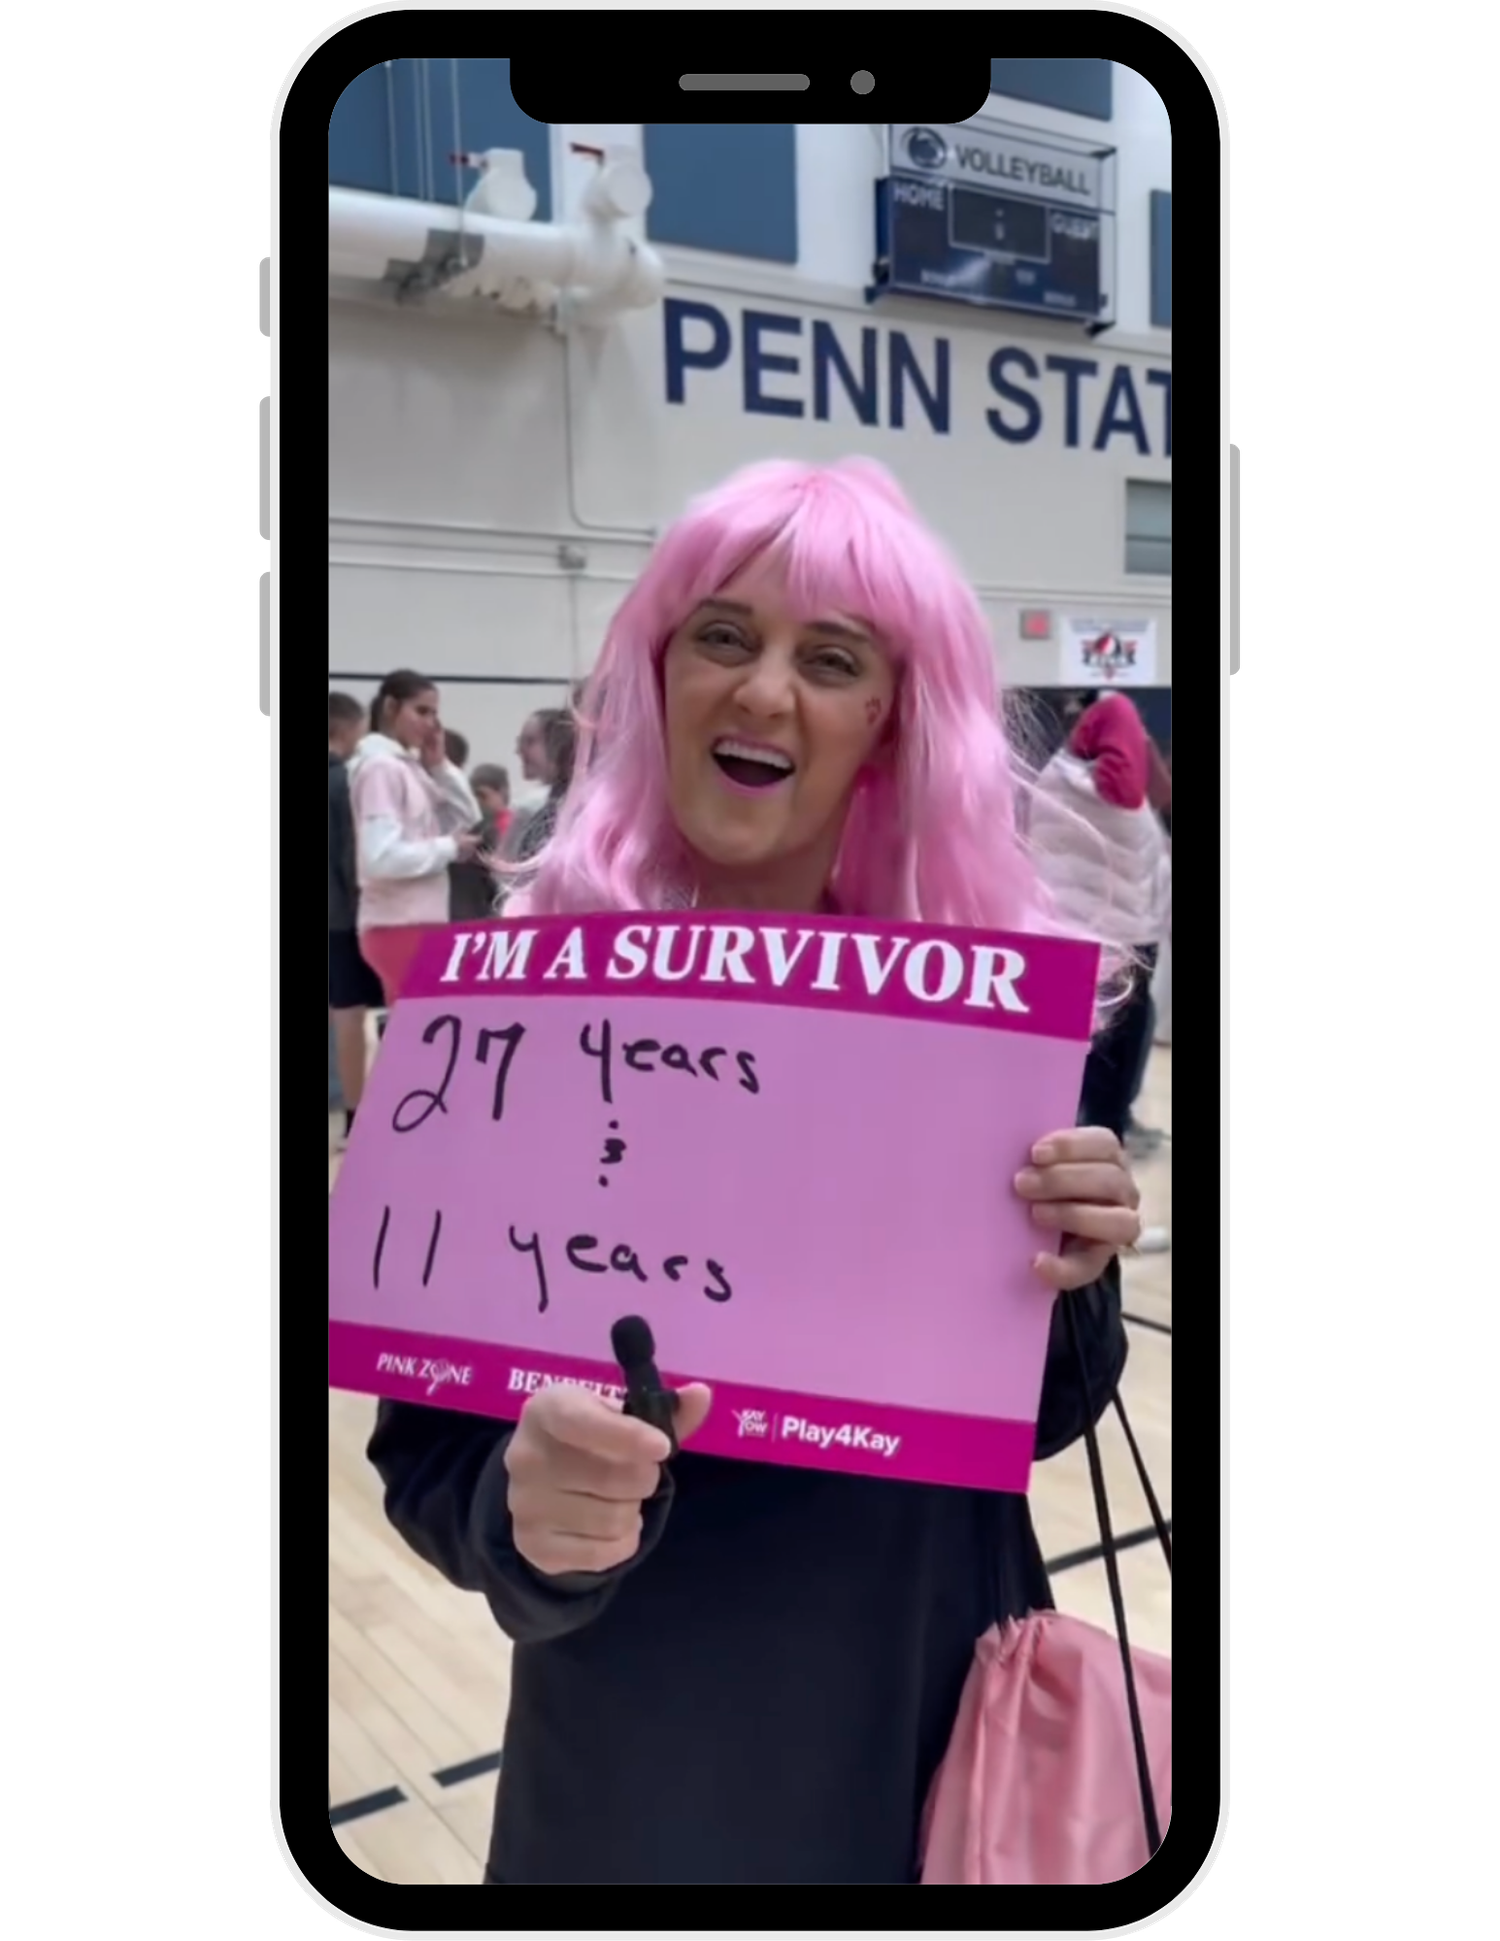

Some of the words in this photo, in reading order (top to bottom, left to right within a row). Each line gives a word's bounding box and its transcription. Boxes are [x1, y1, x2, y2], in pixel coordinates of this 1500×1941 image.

[893, 182, 945, 211] HOME
[955, 144, 1092, 196] VOLLEYBALL
[663, 296, 951, 435] PENN
[438, 930, 540, 982] I'M
[543, 926, 588, 981] A
[605, 924, 1032, 1015] SURVIVOR
[391, 1014, 526, 1133] 27
[373, 1205, 442, 1289] 11
[509, 1224, 734, 1315] years
[376, 1352, 418, 1376] PINK
[417, 1357, 472, 1396] ZONE
[781, 1414, 900, 1457] Play4Kay
